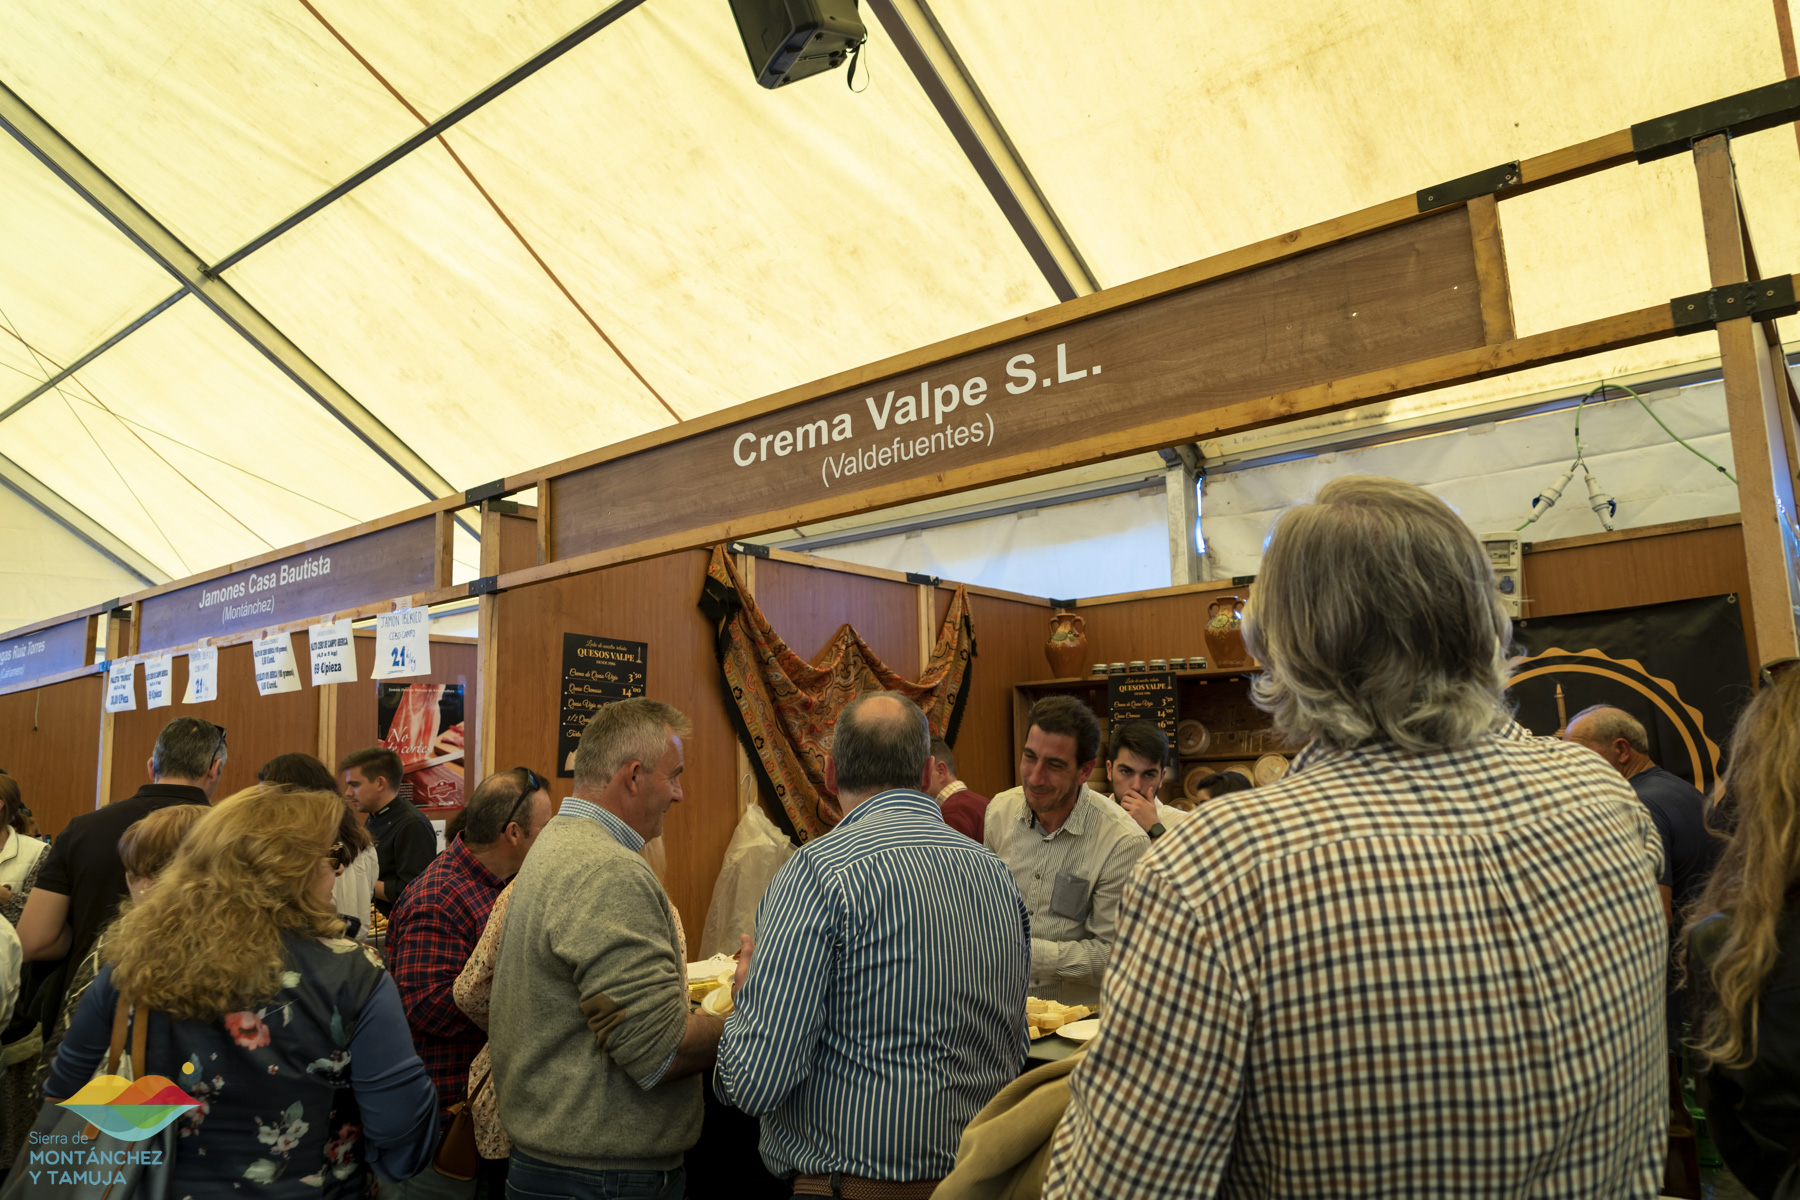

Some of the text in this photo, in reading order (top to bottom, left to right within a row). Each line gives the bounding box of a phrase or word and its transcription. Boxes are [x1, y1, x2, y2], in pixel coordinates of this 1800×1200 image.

[733, 343, 1102, 467] Crema Valpe S.L.
[822, 412, 995, 488] (Valdefuentes)
[199, 555, 331, 608] Jamones Casa Bautista
[222, 595, 275, 624] (Montánchez)
[13, 644, 26, 659] Ruiz
[28, 641, 45, 655] Torres
[391, 646, 405, 666] 21
[577, 648, 635, 662] QUESOS VALPE
[569, 683, 582, 694] Queso
[1119, 684, 1145, 693] QUESOS
[387, 726, 410, 743] No
[400, 741, 430, 754] cortes
